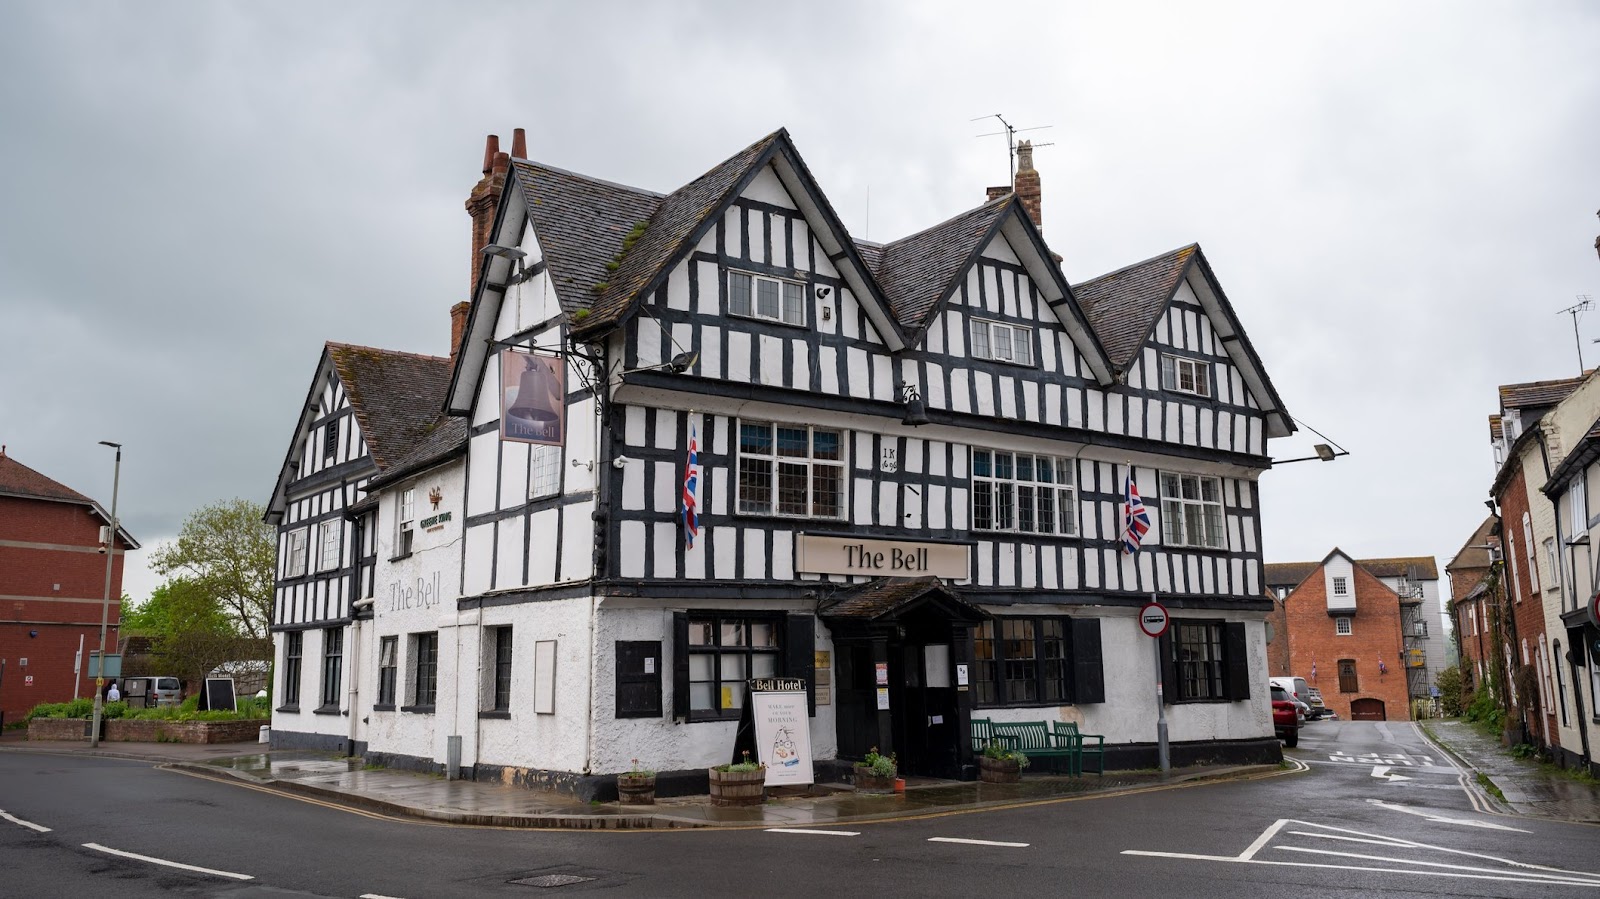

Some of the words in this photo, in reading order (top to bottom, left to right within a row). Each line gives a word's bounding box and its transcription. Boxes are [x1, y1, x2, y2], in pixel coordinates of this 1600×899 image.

[512, 423, 533, 435] The
[536, 426, 555, 437] Bell
[843, 544, 885, 569] The
[891, 547, 929, 571] Bell
[390, 580, 413, 612] The
[416, 571, 441, 608] Bell
[756, 680, 774, 690] Bell
[777, 680, 801, 690] Hotel
